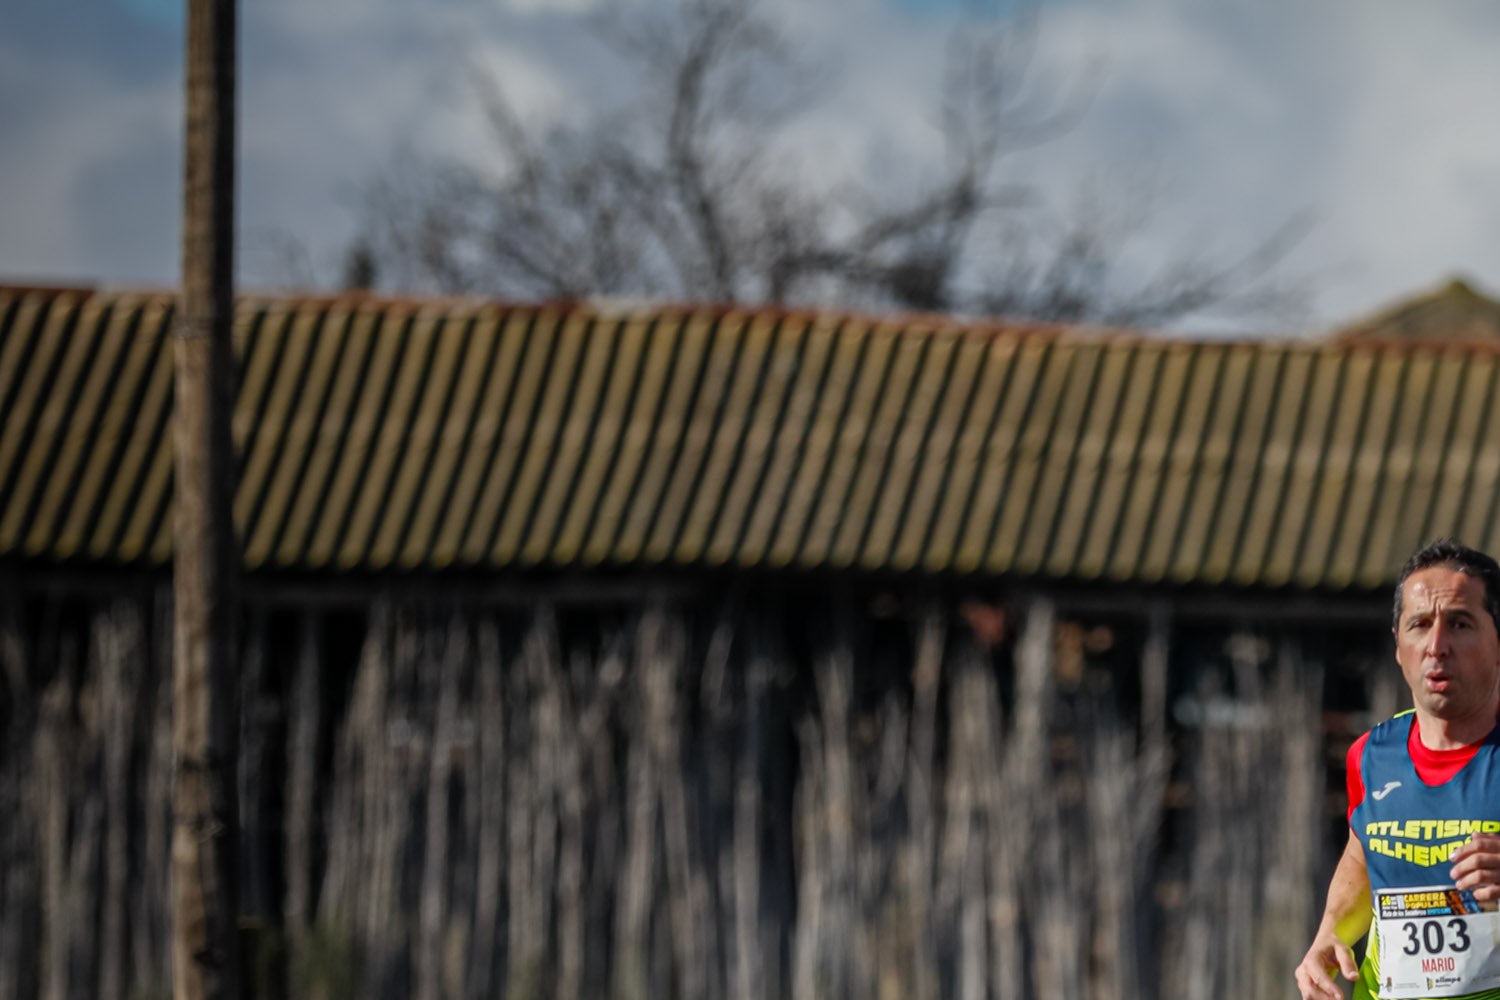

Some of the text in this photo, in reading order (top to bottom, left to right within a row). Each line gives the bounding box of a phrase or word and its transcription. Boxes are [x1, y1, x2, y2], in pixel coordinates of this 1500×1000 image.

[1404, 891, 1447, 901] CARRERA
[1405, 900, 1447, 909] POPULAR
[1402, 918, 1471, 955] 303
[1422, 957, 1455, 973] MARIO
